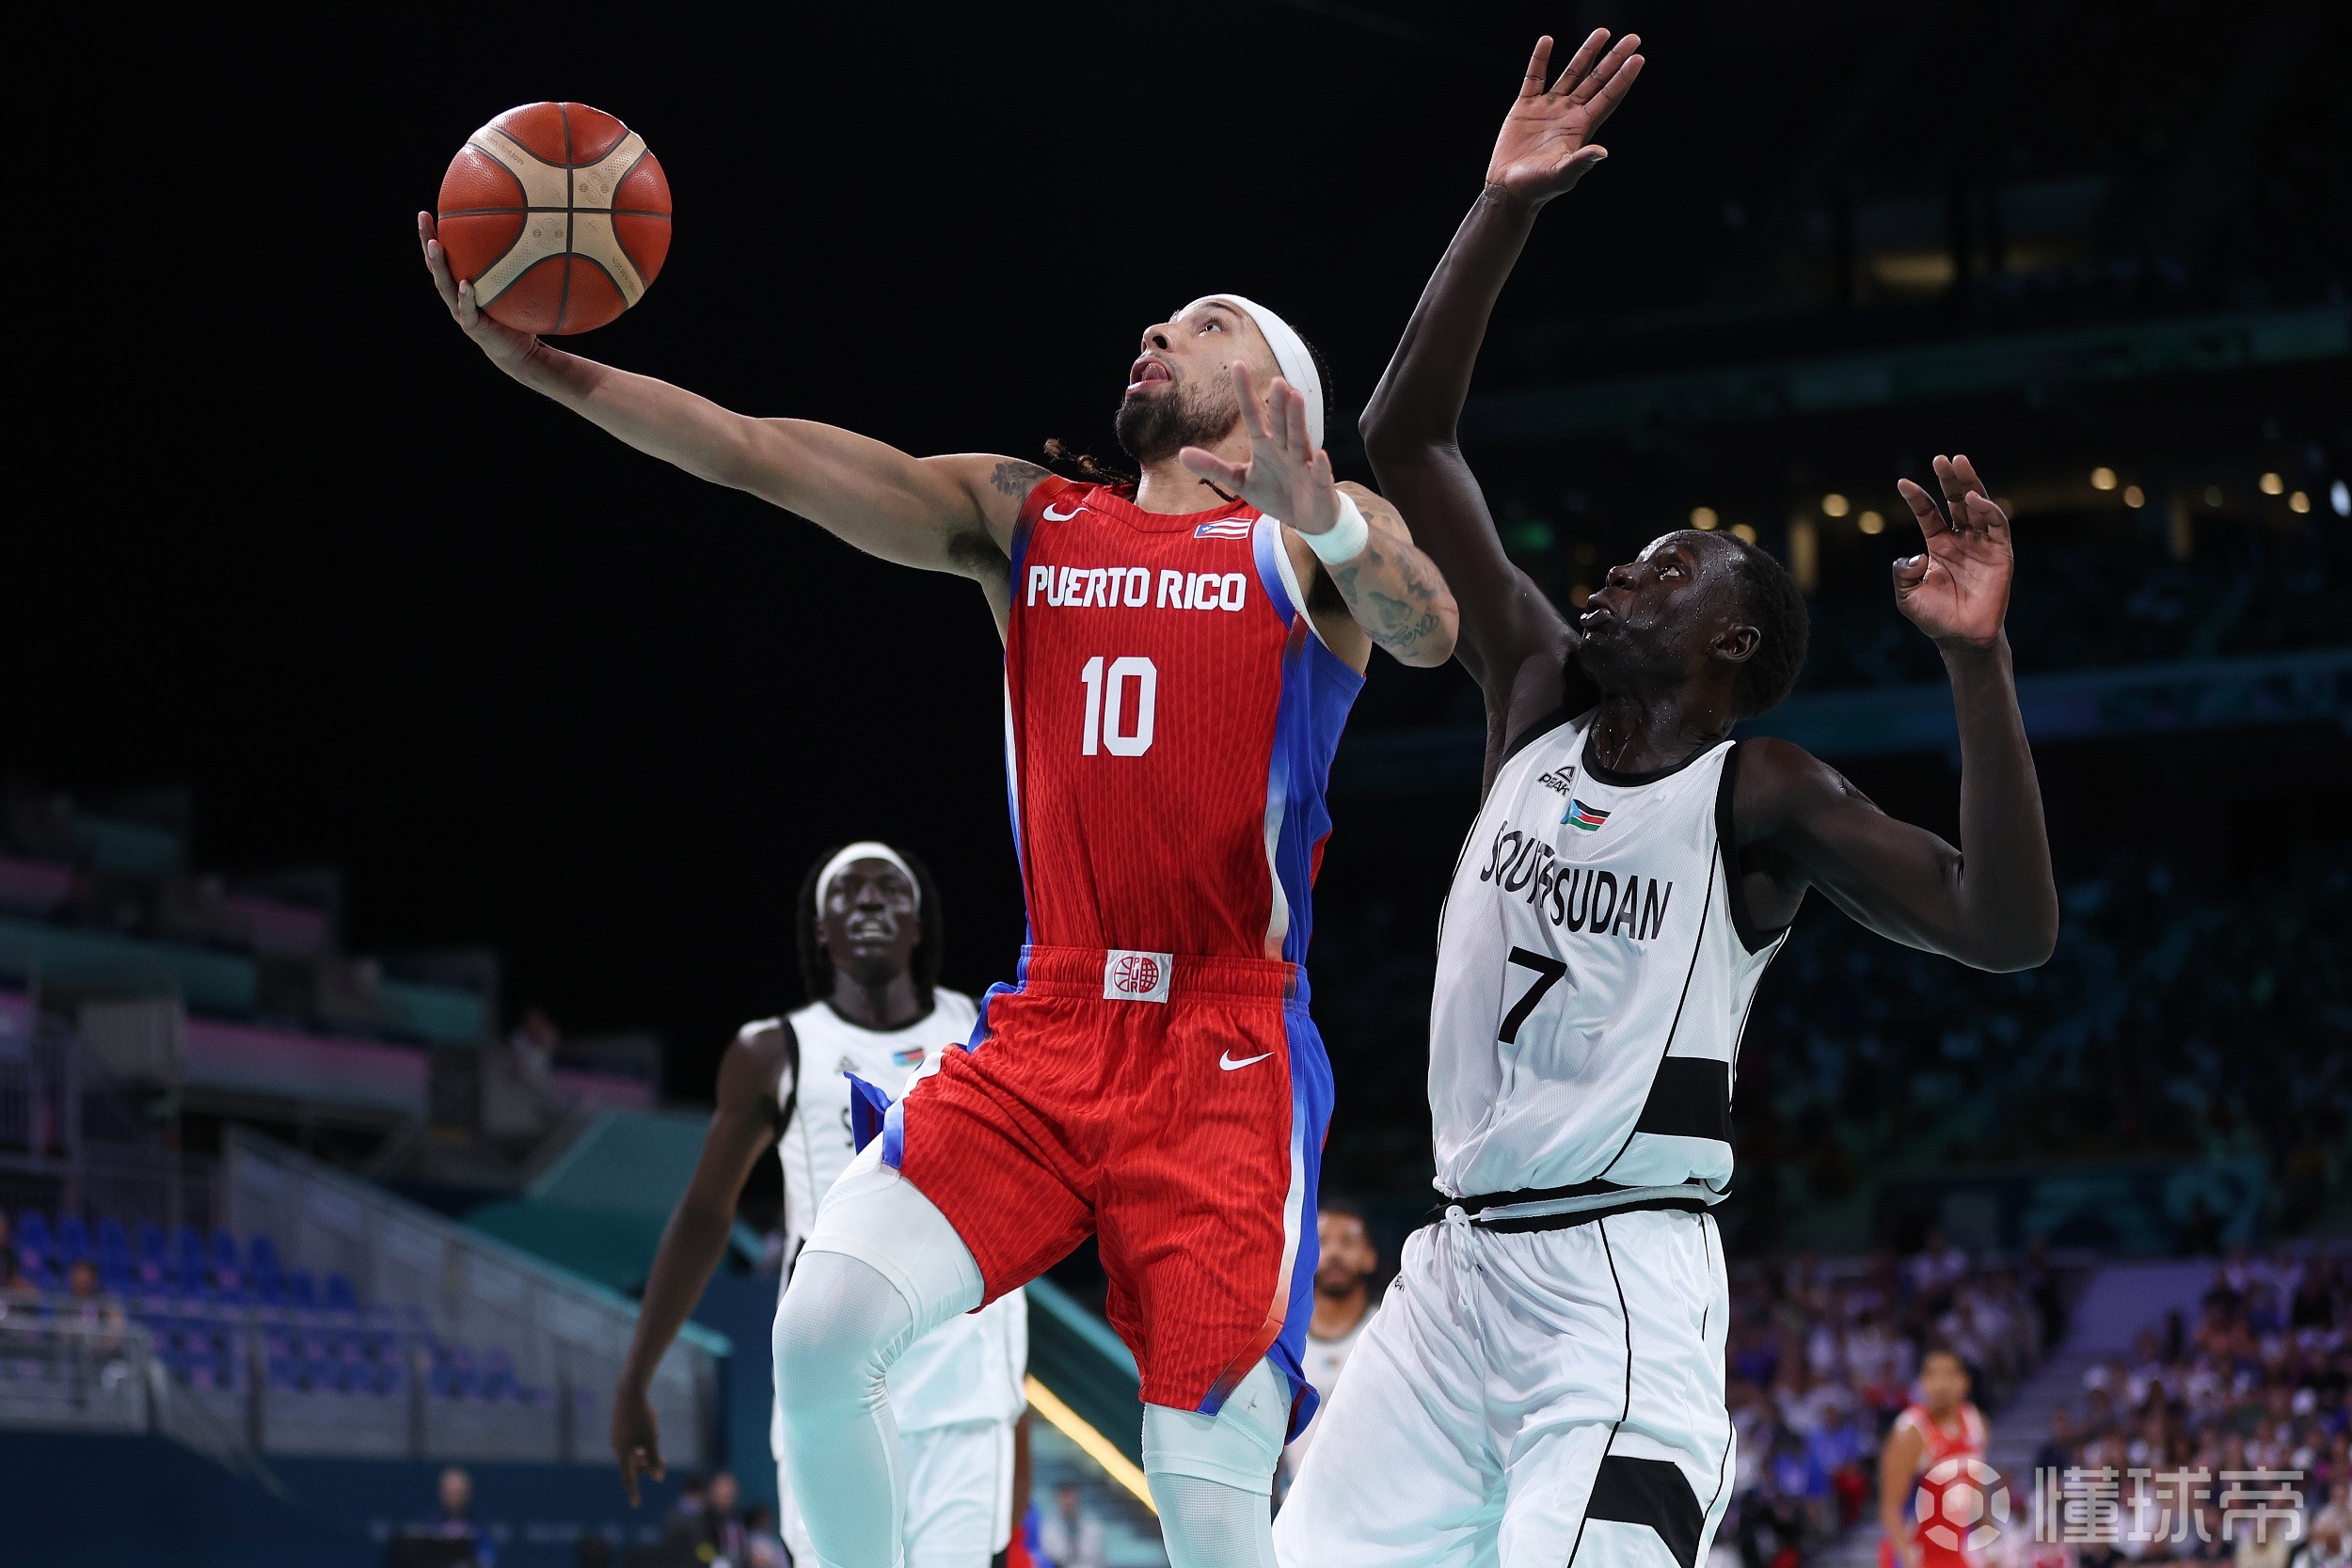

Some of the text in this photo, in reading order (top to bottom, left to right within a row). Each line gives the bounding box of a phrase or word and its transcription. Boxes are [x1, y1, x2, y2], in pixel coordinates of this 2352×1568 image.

[1027, 565, 1247, 611] PUERTO RICO
[1081, 657, 1157, 756] 10
[1538, 773, 1569, 796] PEAK
[1549, 867, 1673, 941] SUDAN
[1498, 945, 1567, 1045] 7
